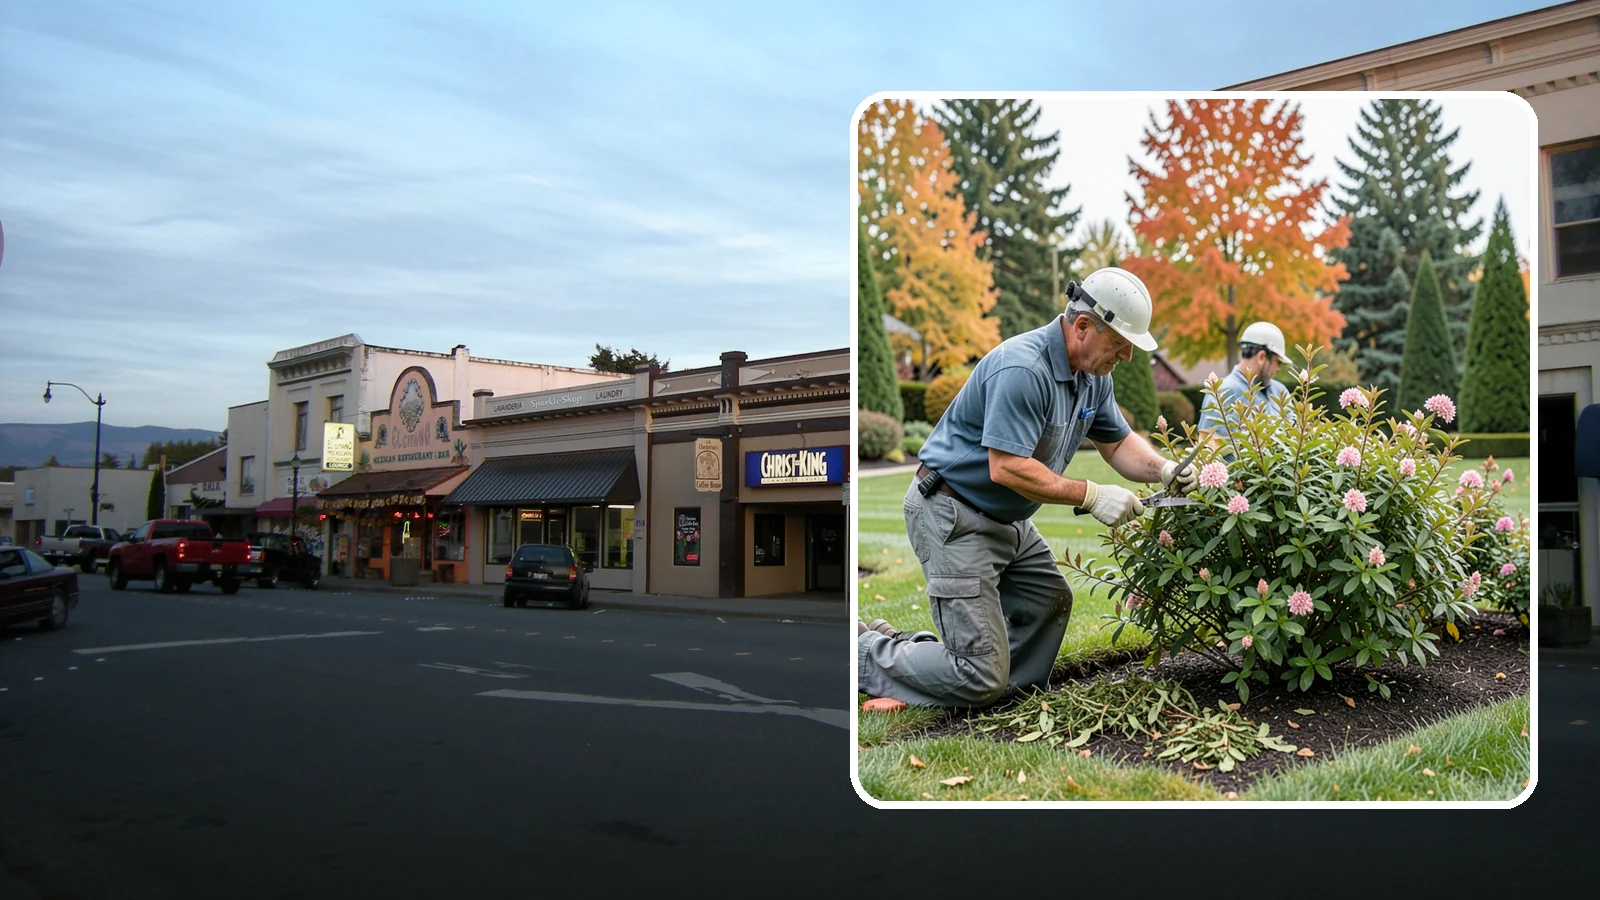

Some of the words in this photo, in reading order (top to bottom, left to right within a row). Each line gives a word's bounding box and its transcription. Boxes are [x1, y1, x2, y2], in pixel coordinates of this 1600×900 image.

[493, 402, 522, 412] LAVANDERIA
[531, 399, 559, 409] Sparkle
[561, 394, 582, 405] Shop
[595, 389, 623, 400] LAUNDRY
[373, 455, 397, 464] MEXICAN
[397, 451, 433, 462] RESTAURANT
[438, 450, 450, 459] BAR
[761, 452, 797, 478] CHRIST
[799, 450, 827, 476] KING
[696, 481, 709, 489] Coffee
[710, 481, 721, 489] House
